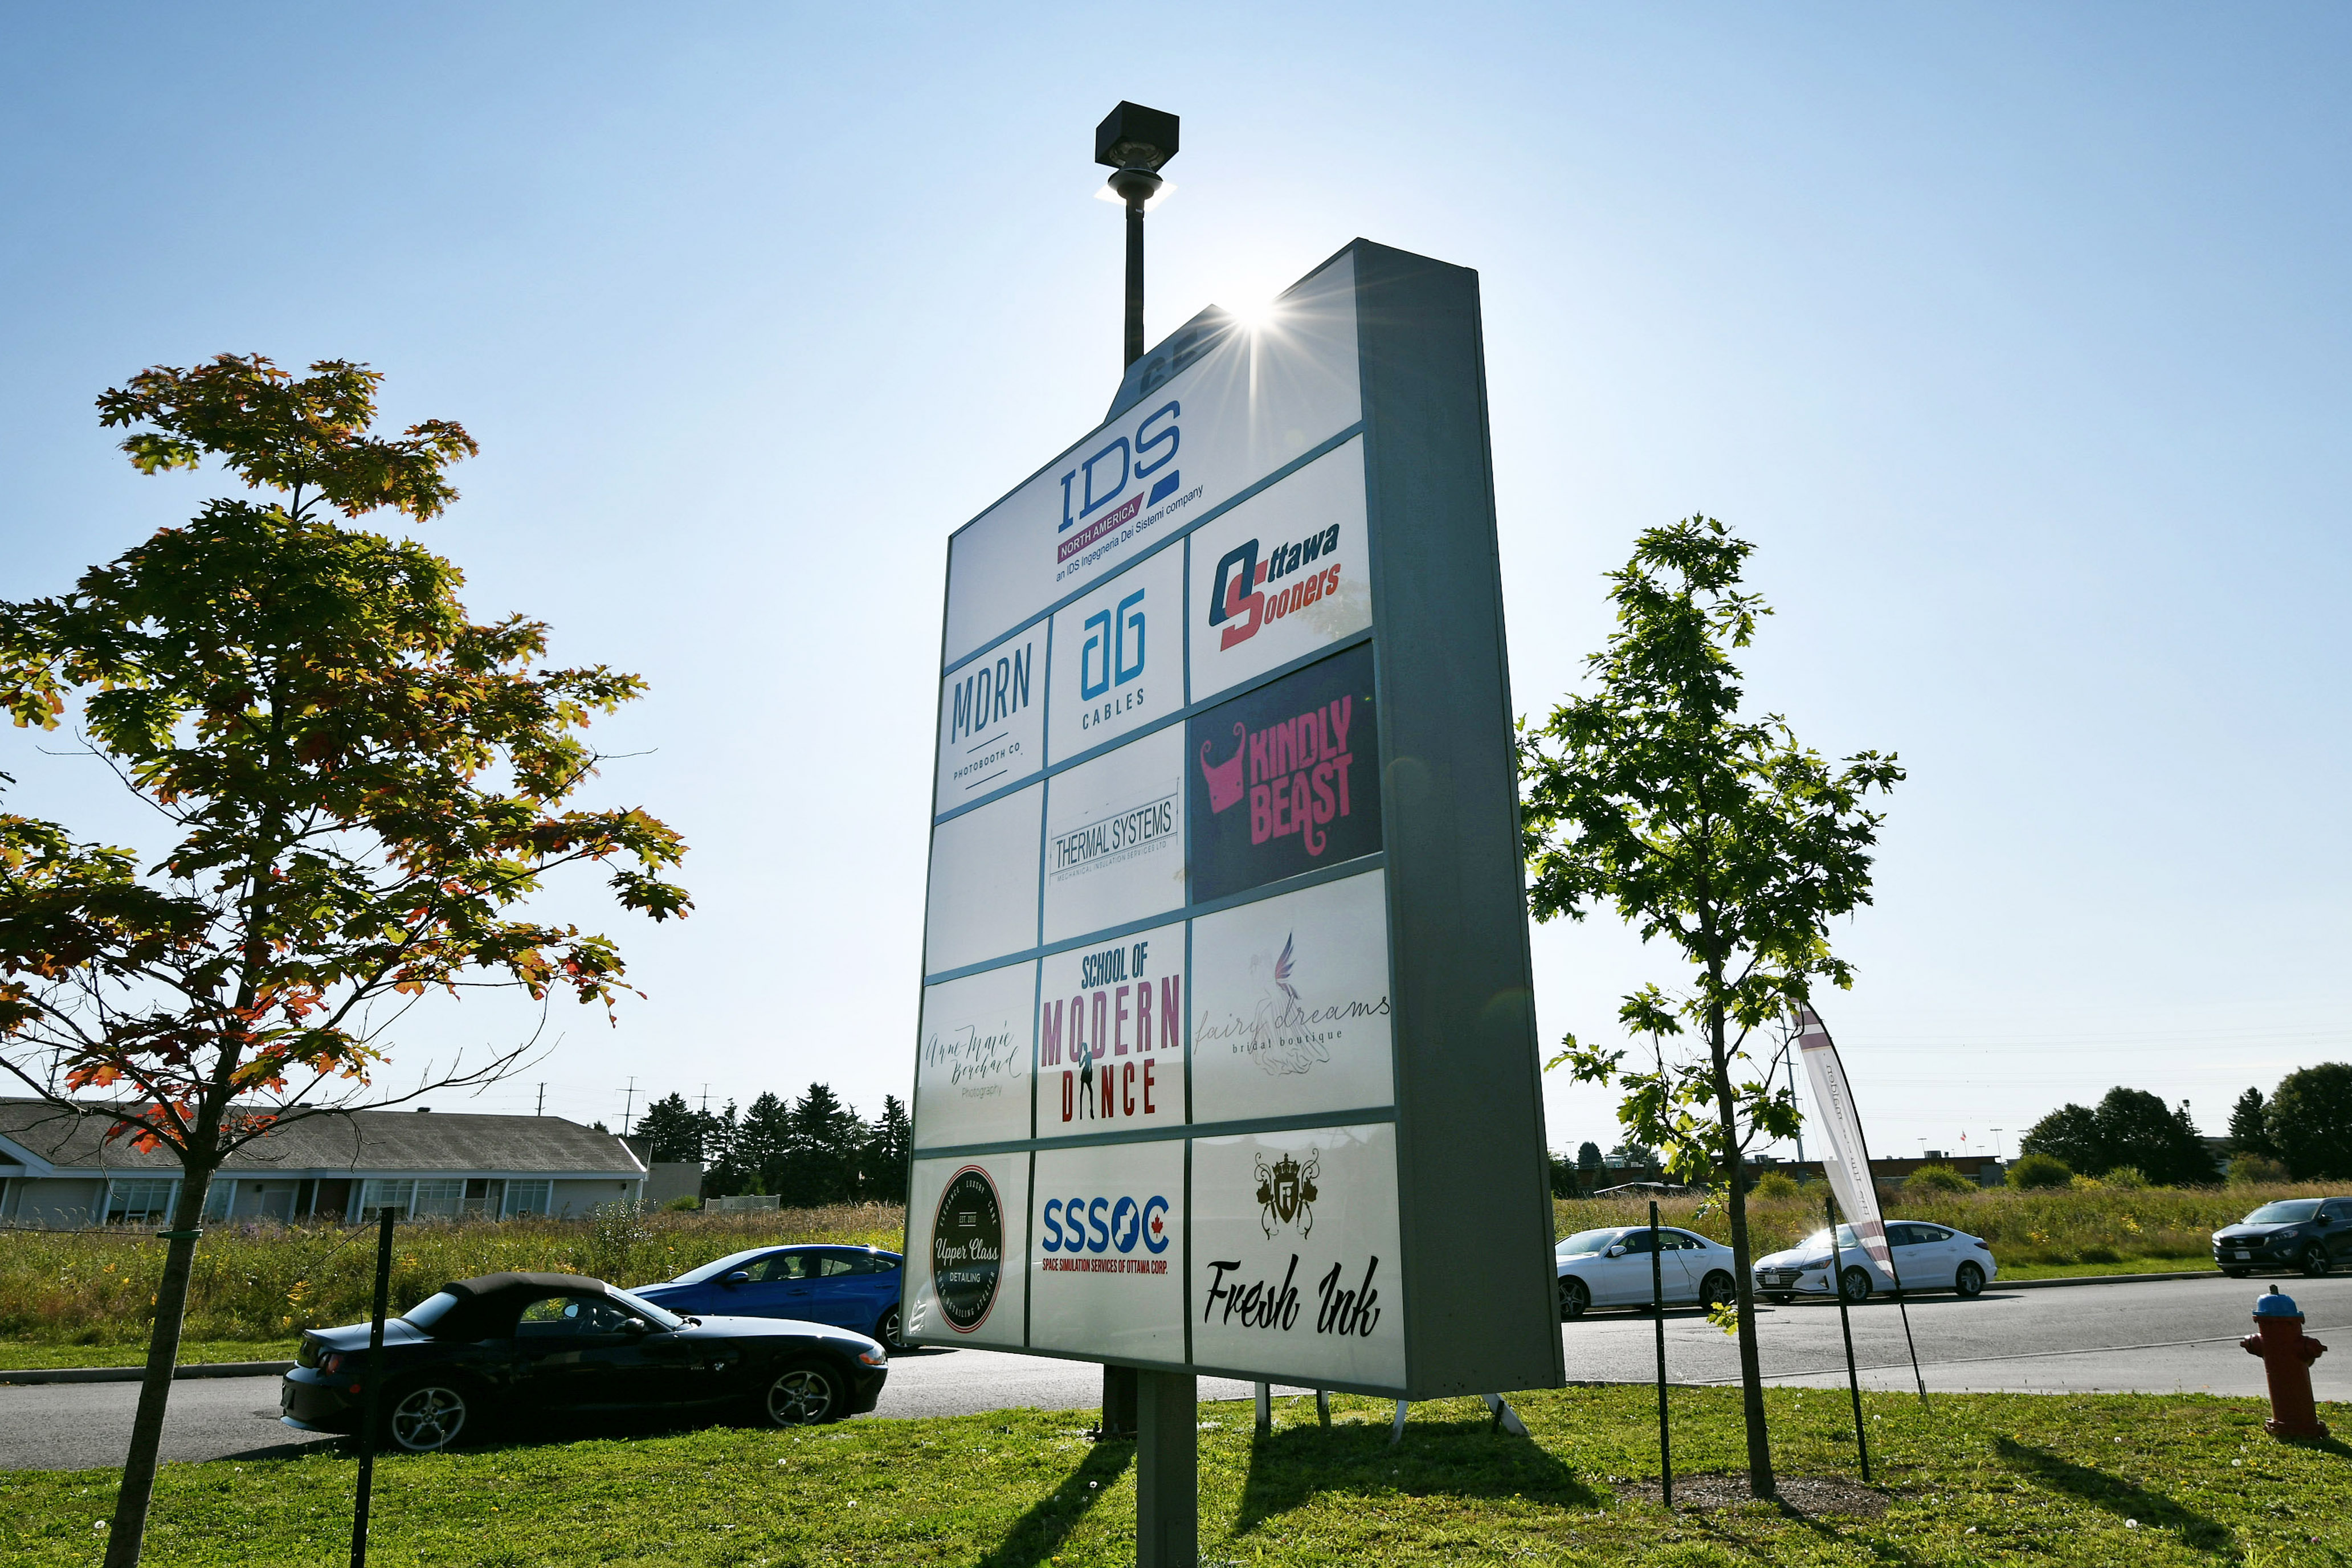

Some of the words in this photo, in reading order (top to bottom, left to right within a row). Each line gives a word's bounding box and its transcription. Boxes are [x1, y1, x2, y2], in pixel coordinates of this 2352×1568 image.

[1058, 400, 1180, 533] IDS
[1056, 570, 1065, 582] an
[1067, 560, 1080, 576] IDS
[1082, 537, 1119, 567] Ingegneria
[1121, 525, 1134, 542] Dei
[1136, 506, 1163, 533] Sistemi
[1166, 484, 1203, 515] company
[1061, 533, 1091, 558] NORTH
[1093, 503, 1135, 538] AMERICA
[951, 642, 1032, 745] MDRN
[1083, 688, 1144, 730] CABLES
[954, 749, 1006, 780] PHOTOBOOTH
[1250, 695, 1351, 785] KINDLY
[1250, 753, 1353, 856] BEAST
[1056, 824, 1109, 868] THERMAL
[1112, 801, 1171, 850] SYSTEMS
[1057, 866, 1092, 882] MECHANICAL
[1093, 855, 1126, 870] INSULATION
[1127, 844, 1155, 860] SERVICES
[1081, 947, 1128, 989] SCHOOL
[1132, 941, 1148, 978] OF
[1042, 974, 1179, 1067] MODERN
[1194, 1010, 1266, 1055] fairy
[1274, 994, 1391, 1029] dreams
[1232, 1039, 1271, 1054] bridal
[1280, 1029, 1342, 1050] boutique
[962, 1084, 1002, 1099] Photography
[936, 1238, 967, 1266] Upper
[969, 1238, 999, 1260] Class
[1042, 1195, 1170, 1254] SSSOC
[949, 1272, 981, 1283] DETAILING
[1042, 1258, 1059, 1271] SPACE
[1059, 1258, 1090, 1272] SIMULATION
[1091, 1259, 1117, 1273] SERVICES
[1118, 1259, 1126, 1273] OF
[1126, 1260, 1150, 1274] OTTAWA
[1151, 1260, 1168, 1275] CORP.
[1204, 1253, 1300, 1331] Fresh
[1317, 1255, 1381, 1337] Ink
